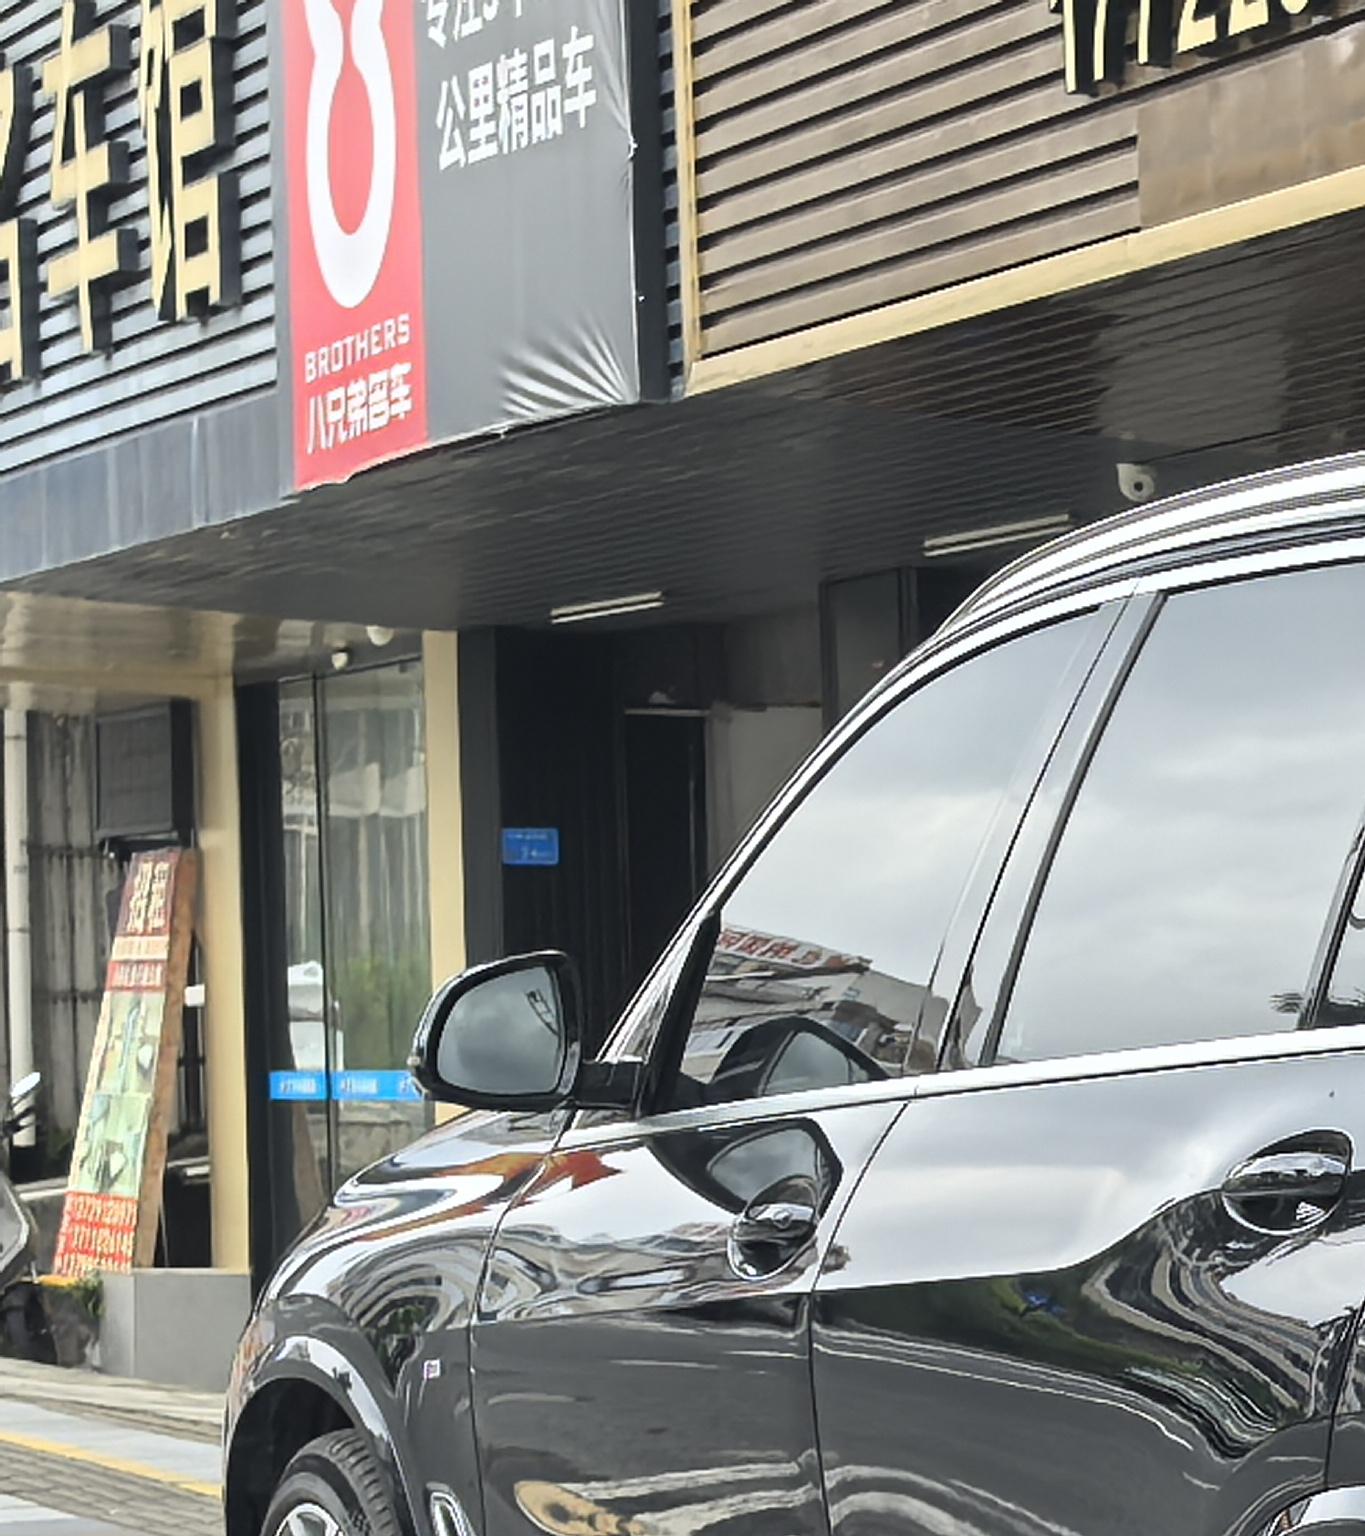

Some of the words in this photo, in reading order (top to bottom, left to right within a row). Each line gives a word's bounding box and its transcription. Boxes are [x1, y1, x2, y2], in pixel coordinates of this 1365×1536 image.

[436, 25, 597, 170] 公里精品车
[0, 0, 221, 380] 车馆
[304, 313, 411, 384] BROTHERS
